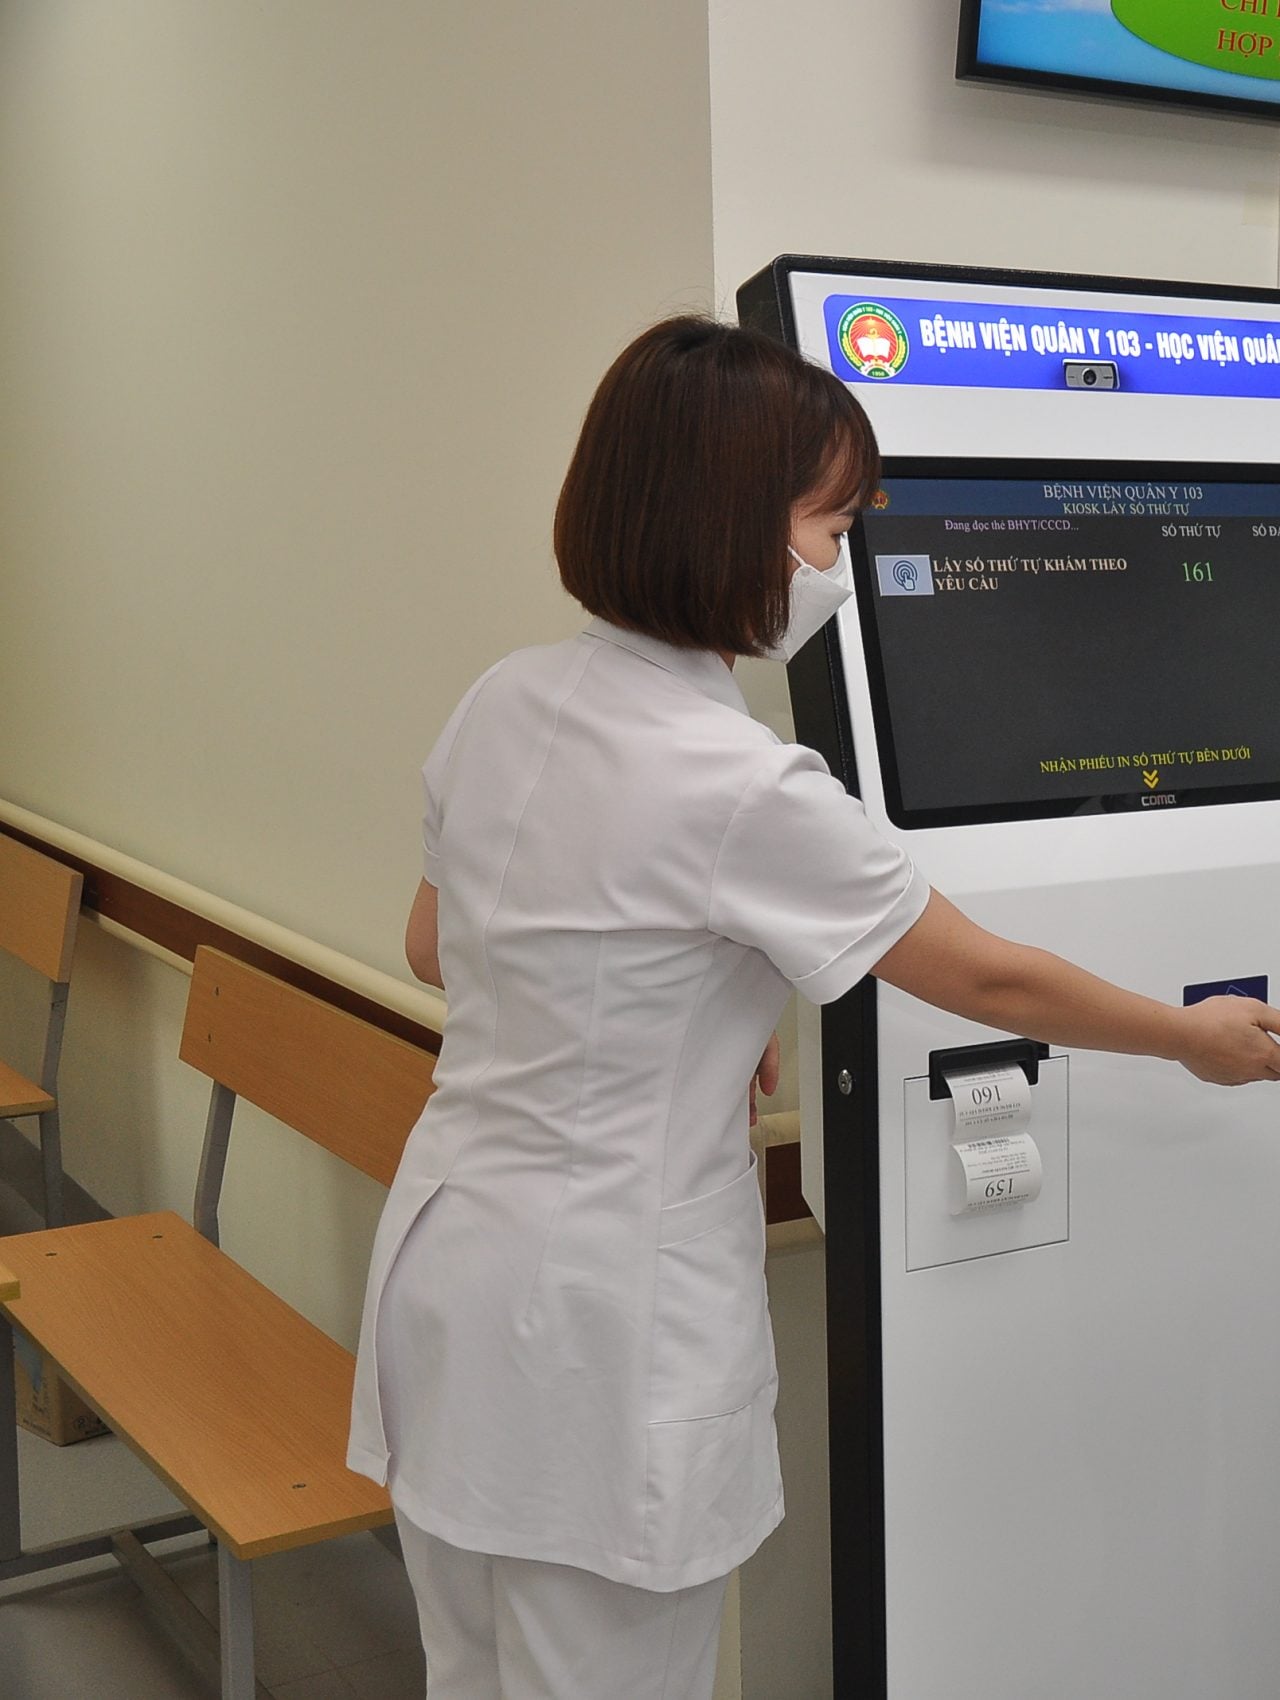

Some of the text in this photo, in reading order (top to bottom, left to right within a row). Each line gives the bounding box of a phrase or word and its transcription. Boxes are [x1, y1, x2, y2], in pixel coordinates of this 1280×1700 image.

[1217, 29, 1273, 58] HỢP
[919, 313, 977, 354] BỆNH
[978, 317, 1028, 357] VIỆN
[1030, 321, 1086, 355] QUÂN
[1087, 328, 1101, 355] Y
[1105, 329, 1141, 357] 103
[1156, 331, 1195, 365] HỌC
[1196, 329, 1240, 367] VIỆN
[1043, 482, 1203, 501] BỆNH VIỆN QUÂN Y 103
[1063, 501, 1190, 516] KIOSK LẤY SỐ THỨ TỰ
[944, 519, 970, 533] Đang
[1161, 523, 1222, 539] SỐ THỨ TỰ
[1252, 523, 1267, 537] SỐ
[932, 555, 1127, 574] LẤY SỐ THỨ TỰ KHÁM THEO
[1182, 561, 1214, 582] 161
[935, 574, 999, 591] YÊU CẦU
[1040, 746, 1251, 774] NHẬN PHIẾU IN SỐ THỨ TỰ BÊN DƯỚI
[971, 1084, 1002, 1106] 160
[985, 1178, 1014, 1198] 159
